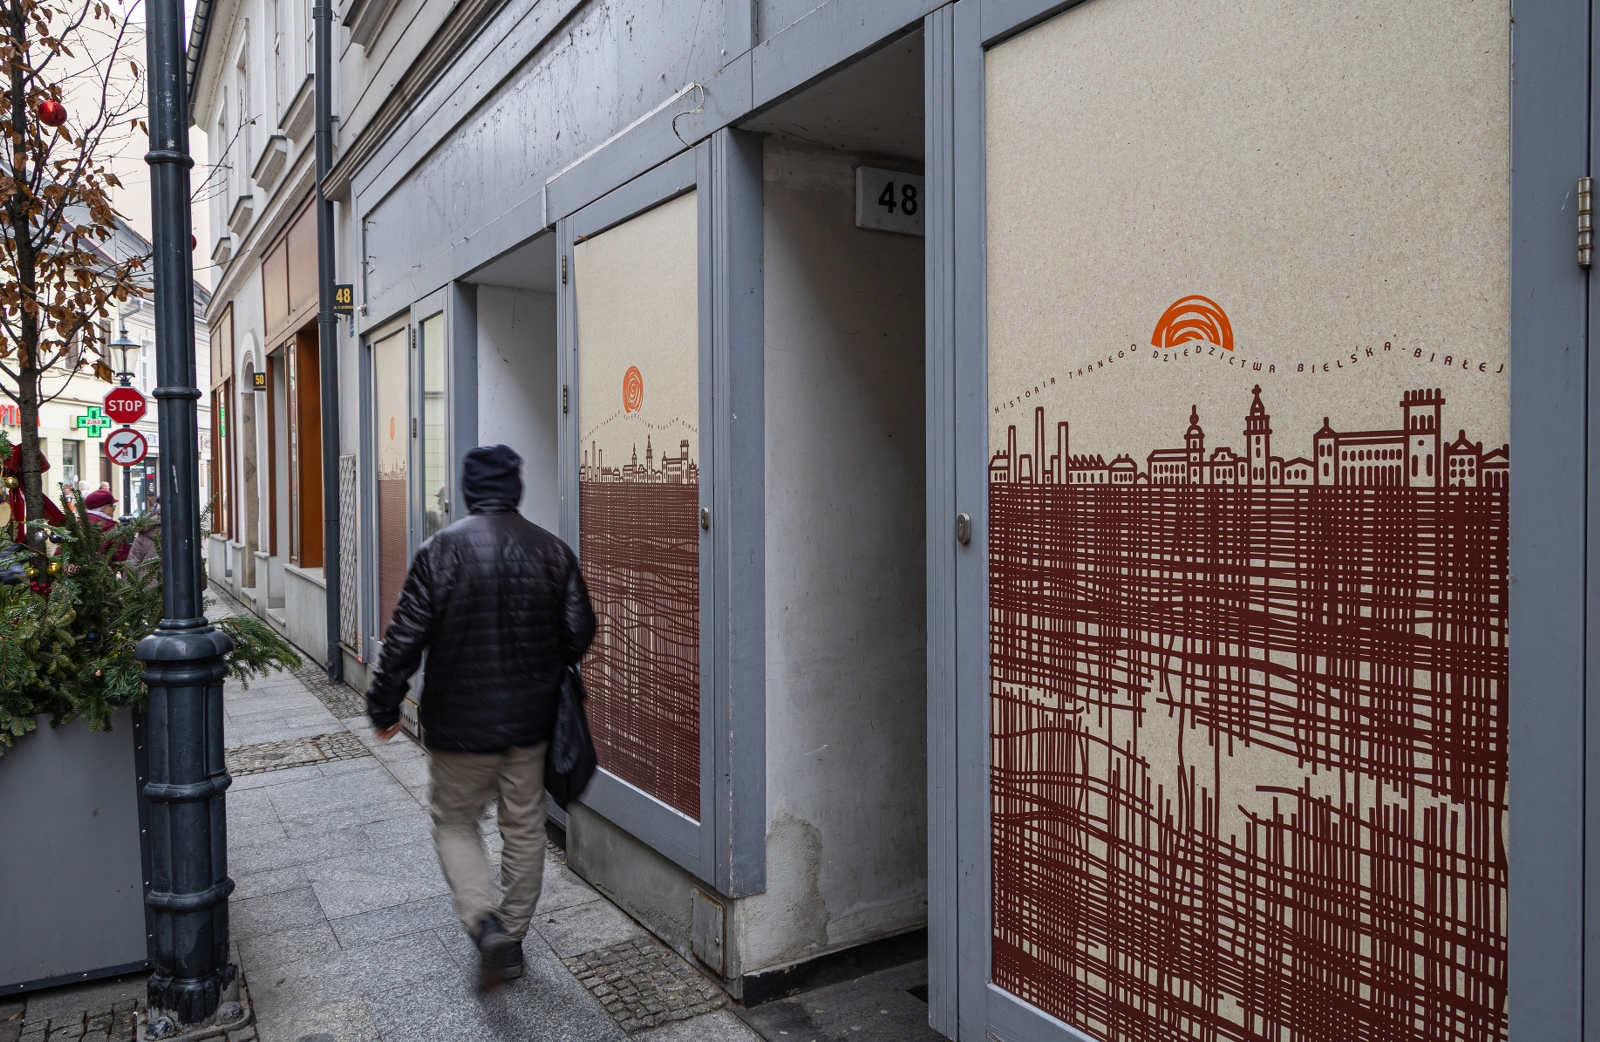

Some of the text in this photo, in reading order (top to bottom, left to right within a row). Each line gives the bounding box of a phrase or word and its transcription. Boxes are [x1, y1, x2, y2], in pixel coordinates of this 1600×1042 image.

[878, 181, 918, 216] 48
[335, 288, 351, 303] 48
[255, 374, 265, 385] 50
[994, 377, 1056, 414] HISTORIA
[1068, 343, 1137, 379] TKANEGO
[1152, 345, 1276, 374] DZIEDZICTWA
[108, 399, 143, 412] STOP
